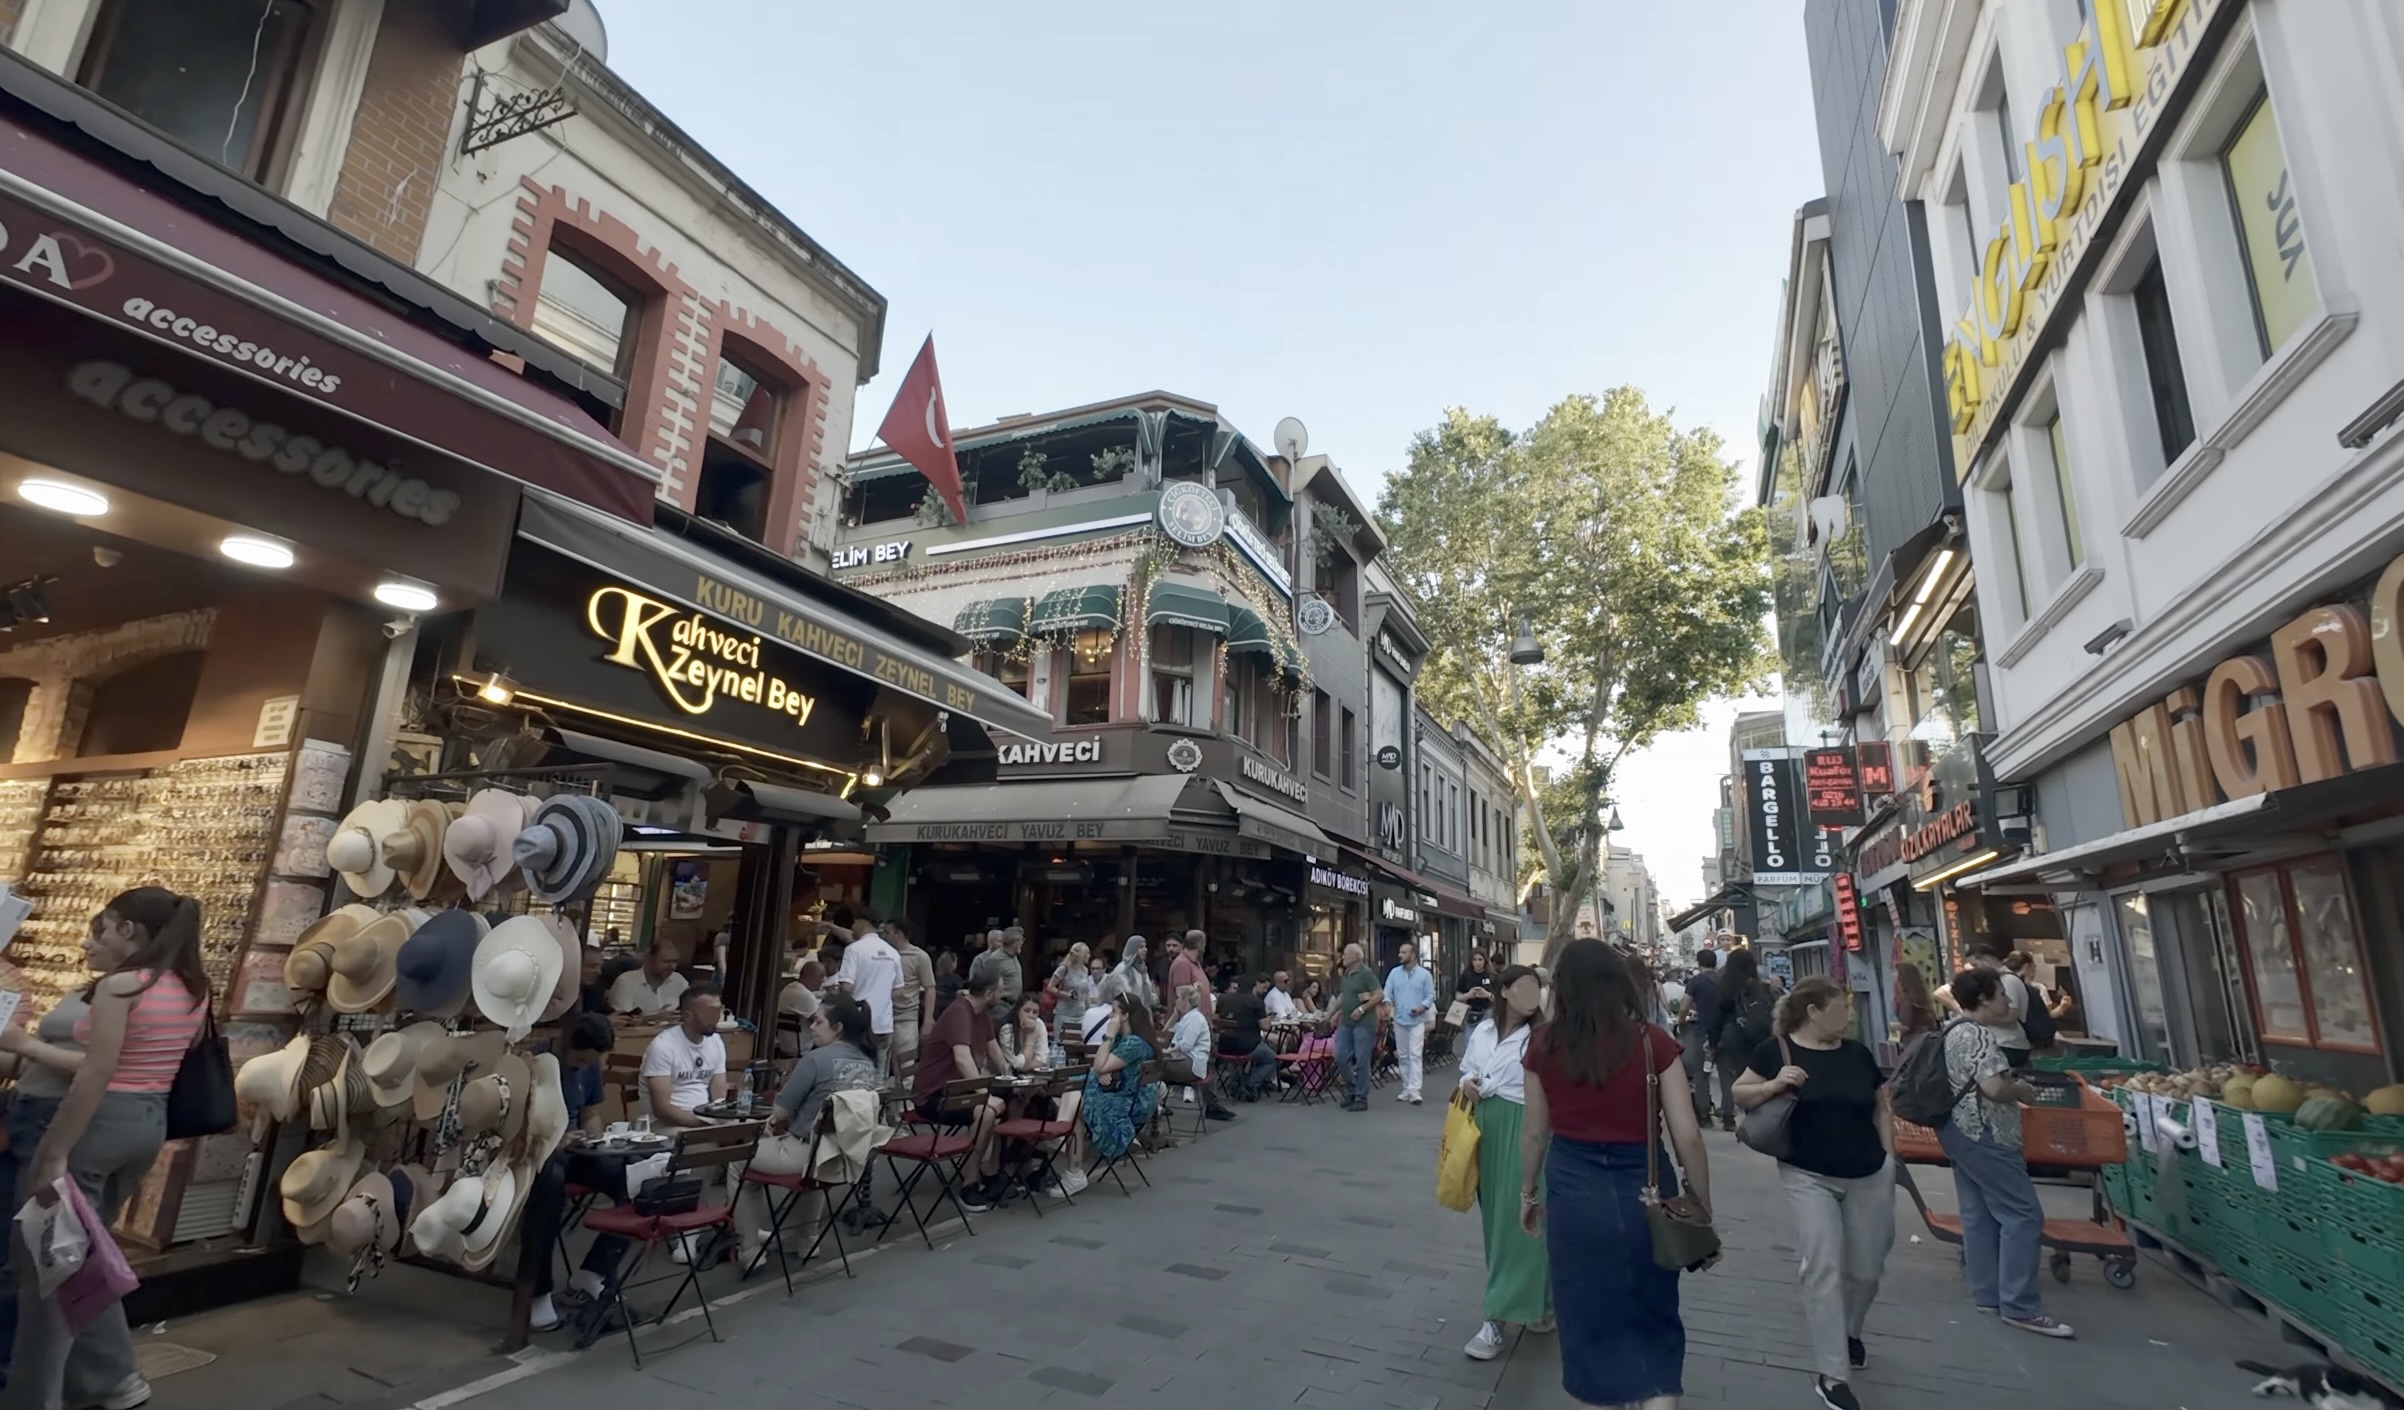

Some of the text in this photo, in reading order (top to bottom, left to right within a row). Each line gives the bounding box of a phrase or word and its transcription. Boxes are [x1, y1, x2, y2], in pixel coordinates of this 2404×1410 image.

[1983, 338, 2021, 423] OKULU
[2026, 314, 2036, 338] &
[2039, 136, 2127, 310] YURTDIŞI
[123, 297, 341, 393] accessories
[70, 361, 460, 525] accessories
[875, 541, 909, 561] BEY
[588, 587, 761, 714] Kahveci
[696, 576, 975, 712] KURU KAHVECİ ZEYNEL BEY
[668, 645, 815, 726] Zeynel Bey
[998, 735, 1100, 764] KAHVECİ
[1243, 756, 1308, 803] KURUKAHVECİ
[917, 822, 1104, 840] KURUKAHVECİ YAVUZ BEY
[1196, 837, 1230, 853] YAVUZ
[1240, 842, 1260, 856] BEY
[1759, 762, 1784, 868] BARGELLO
[1901, 799, 1974, 863] KIZILKAYALAR
[1757, 871, 1798, 883] PARFÜM
